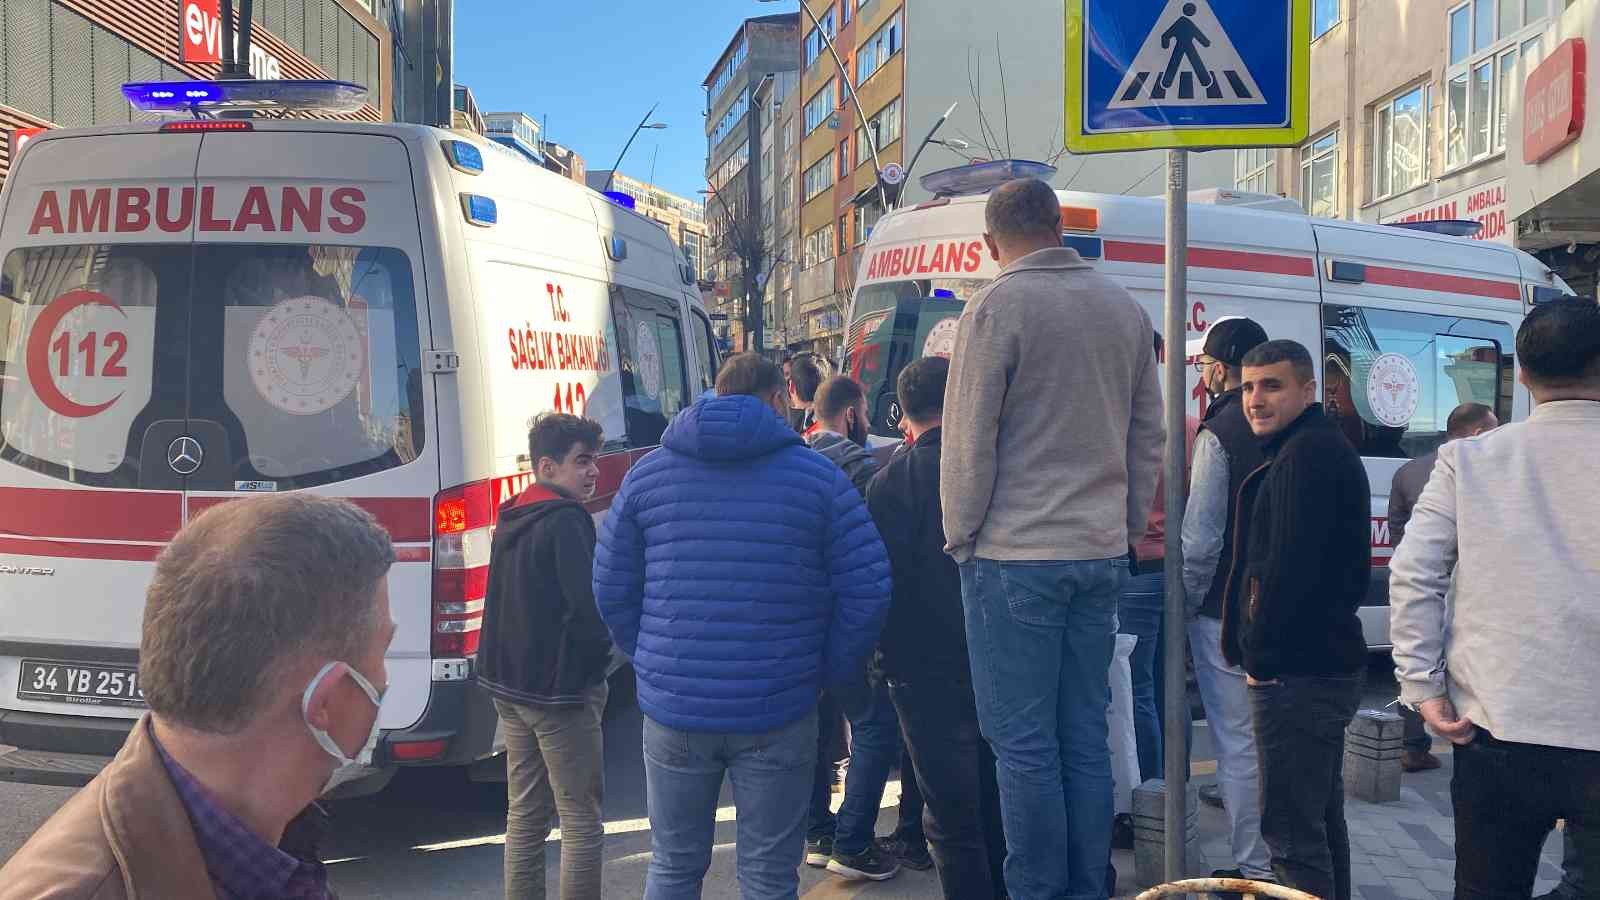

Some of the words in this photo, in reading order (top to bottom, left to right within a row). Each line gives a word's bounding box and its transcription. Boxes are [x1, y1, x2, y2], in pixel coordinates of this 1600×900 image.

[28, 186, 366, 235] AMBULANS
[867, 241, 983, 279] AMBULANS
[546, 283, 571, 322] T.C.
[52, 331, 129, 377] 112
[508, 321, 557, 370] SAĞLIK
[32, 667, 58, 690] 34
[65, 669, 91, 692] YB
[95, 671, 145, 697] 251
